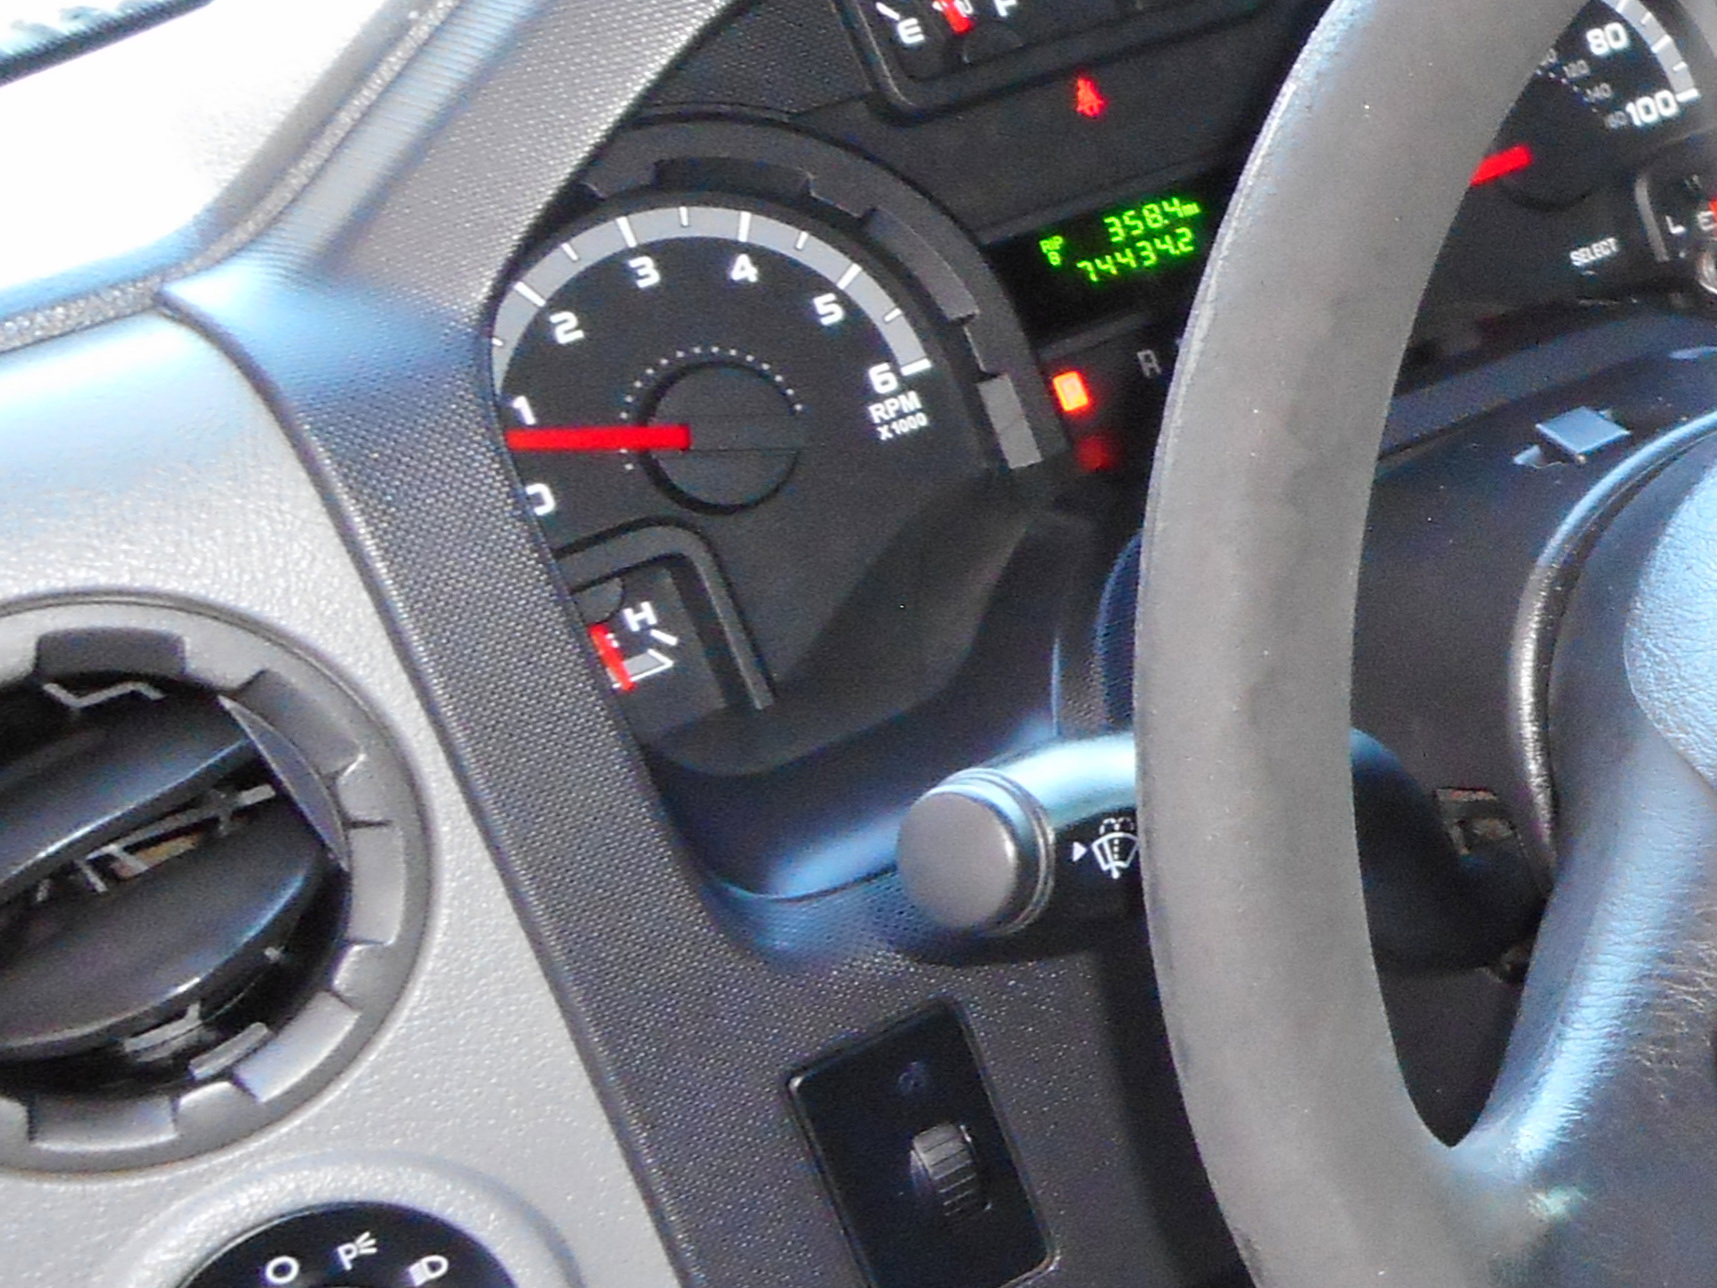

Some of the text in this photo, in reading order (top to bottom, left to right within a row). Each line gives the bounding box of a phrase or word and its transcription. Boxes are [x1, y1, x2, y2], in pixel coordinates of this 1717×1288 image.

[897, 17, 926, 45] E
[1585, 21, 1631, 57] 80
[1625, 88, 1681, 128] 100
[729, 252, 760, 284] 4
[1076, 226, 1195, 283] 74434.2
[1569, 236, 1620, 268] SELECT
[627, 255, 661, 289] 3
[812, 291, 846, 327] 5
[549, 309, 586, 345] 2
[867, 361, 899, 396] 6
[511, 394, 538, 426] 1
[867, 391, 924, 426] RPM
[622, 601, 658, 633] H
